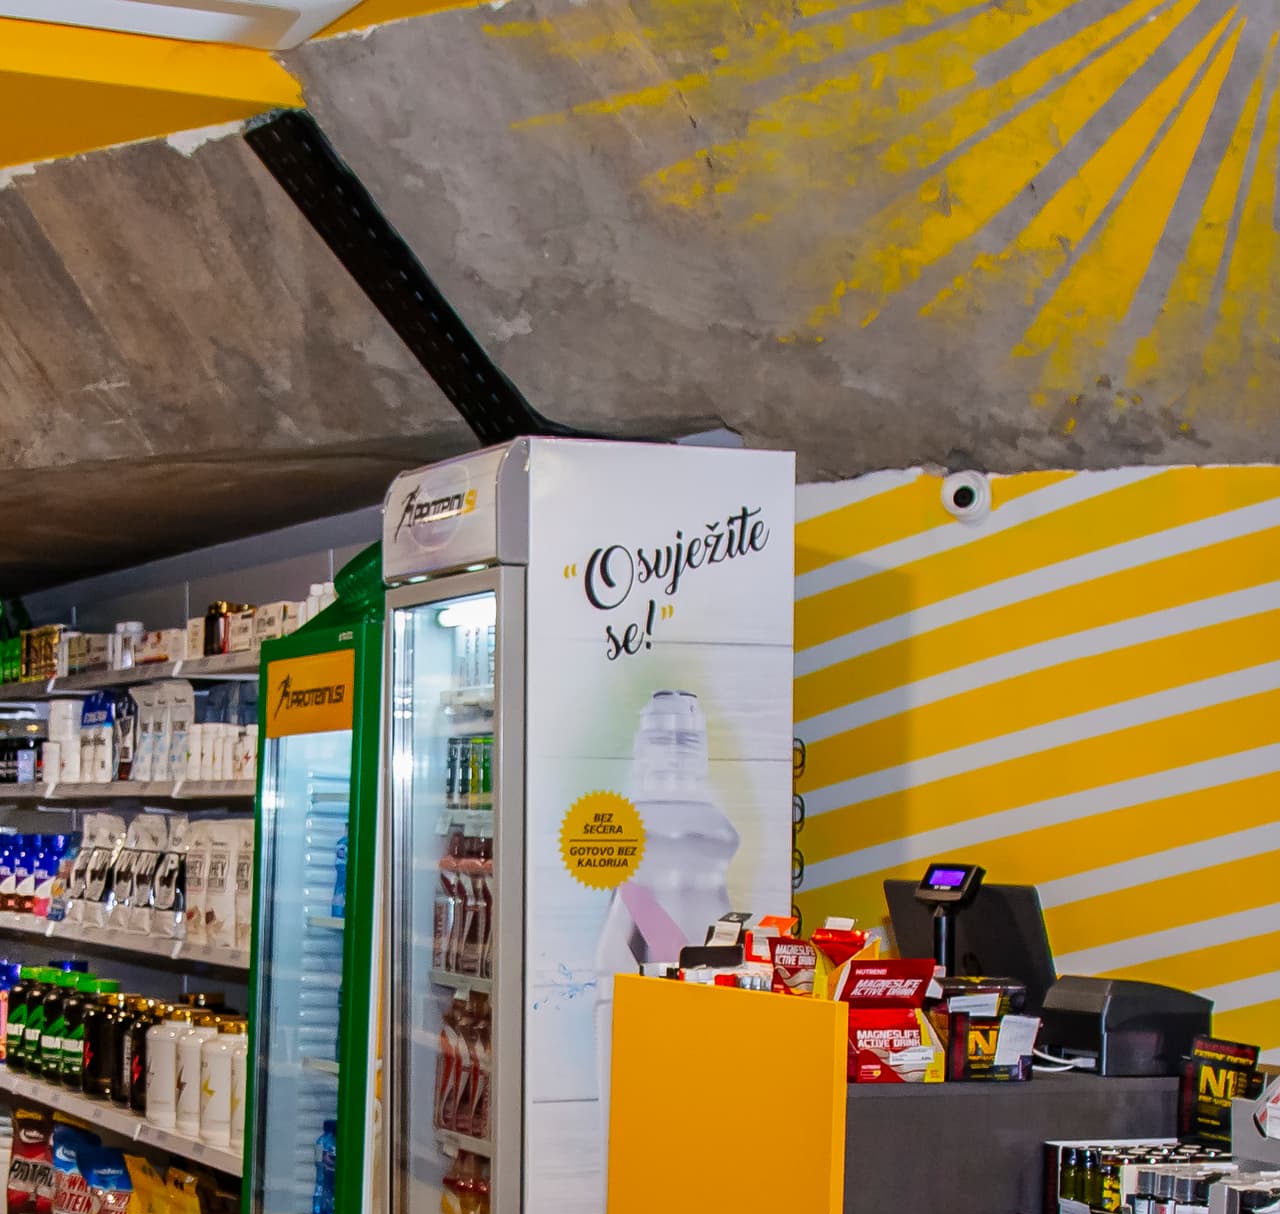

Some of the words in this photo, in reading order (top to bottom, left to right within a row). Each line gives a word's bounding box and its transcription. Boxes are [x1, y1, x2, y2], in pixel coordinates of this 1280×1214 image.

[593, 813, 614, 823] BEZ
[569, 846, 615, 857] GOTOVO
[617, 846, 638, 856] BEZ
[577, 858, 629, 868] KALORIJA
[855, 968, 888, 976] NUTREND
[854, 978, 923, 990] MAGNESLIFE
[856, 1029, 921, 1040] MAGNESLIFE
[857, 1039, 890, 1048] ACTIVE
[893, 1038, 921, 1048] DRINK
